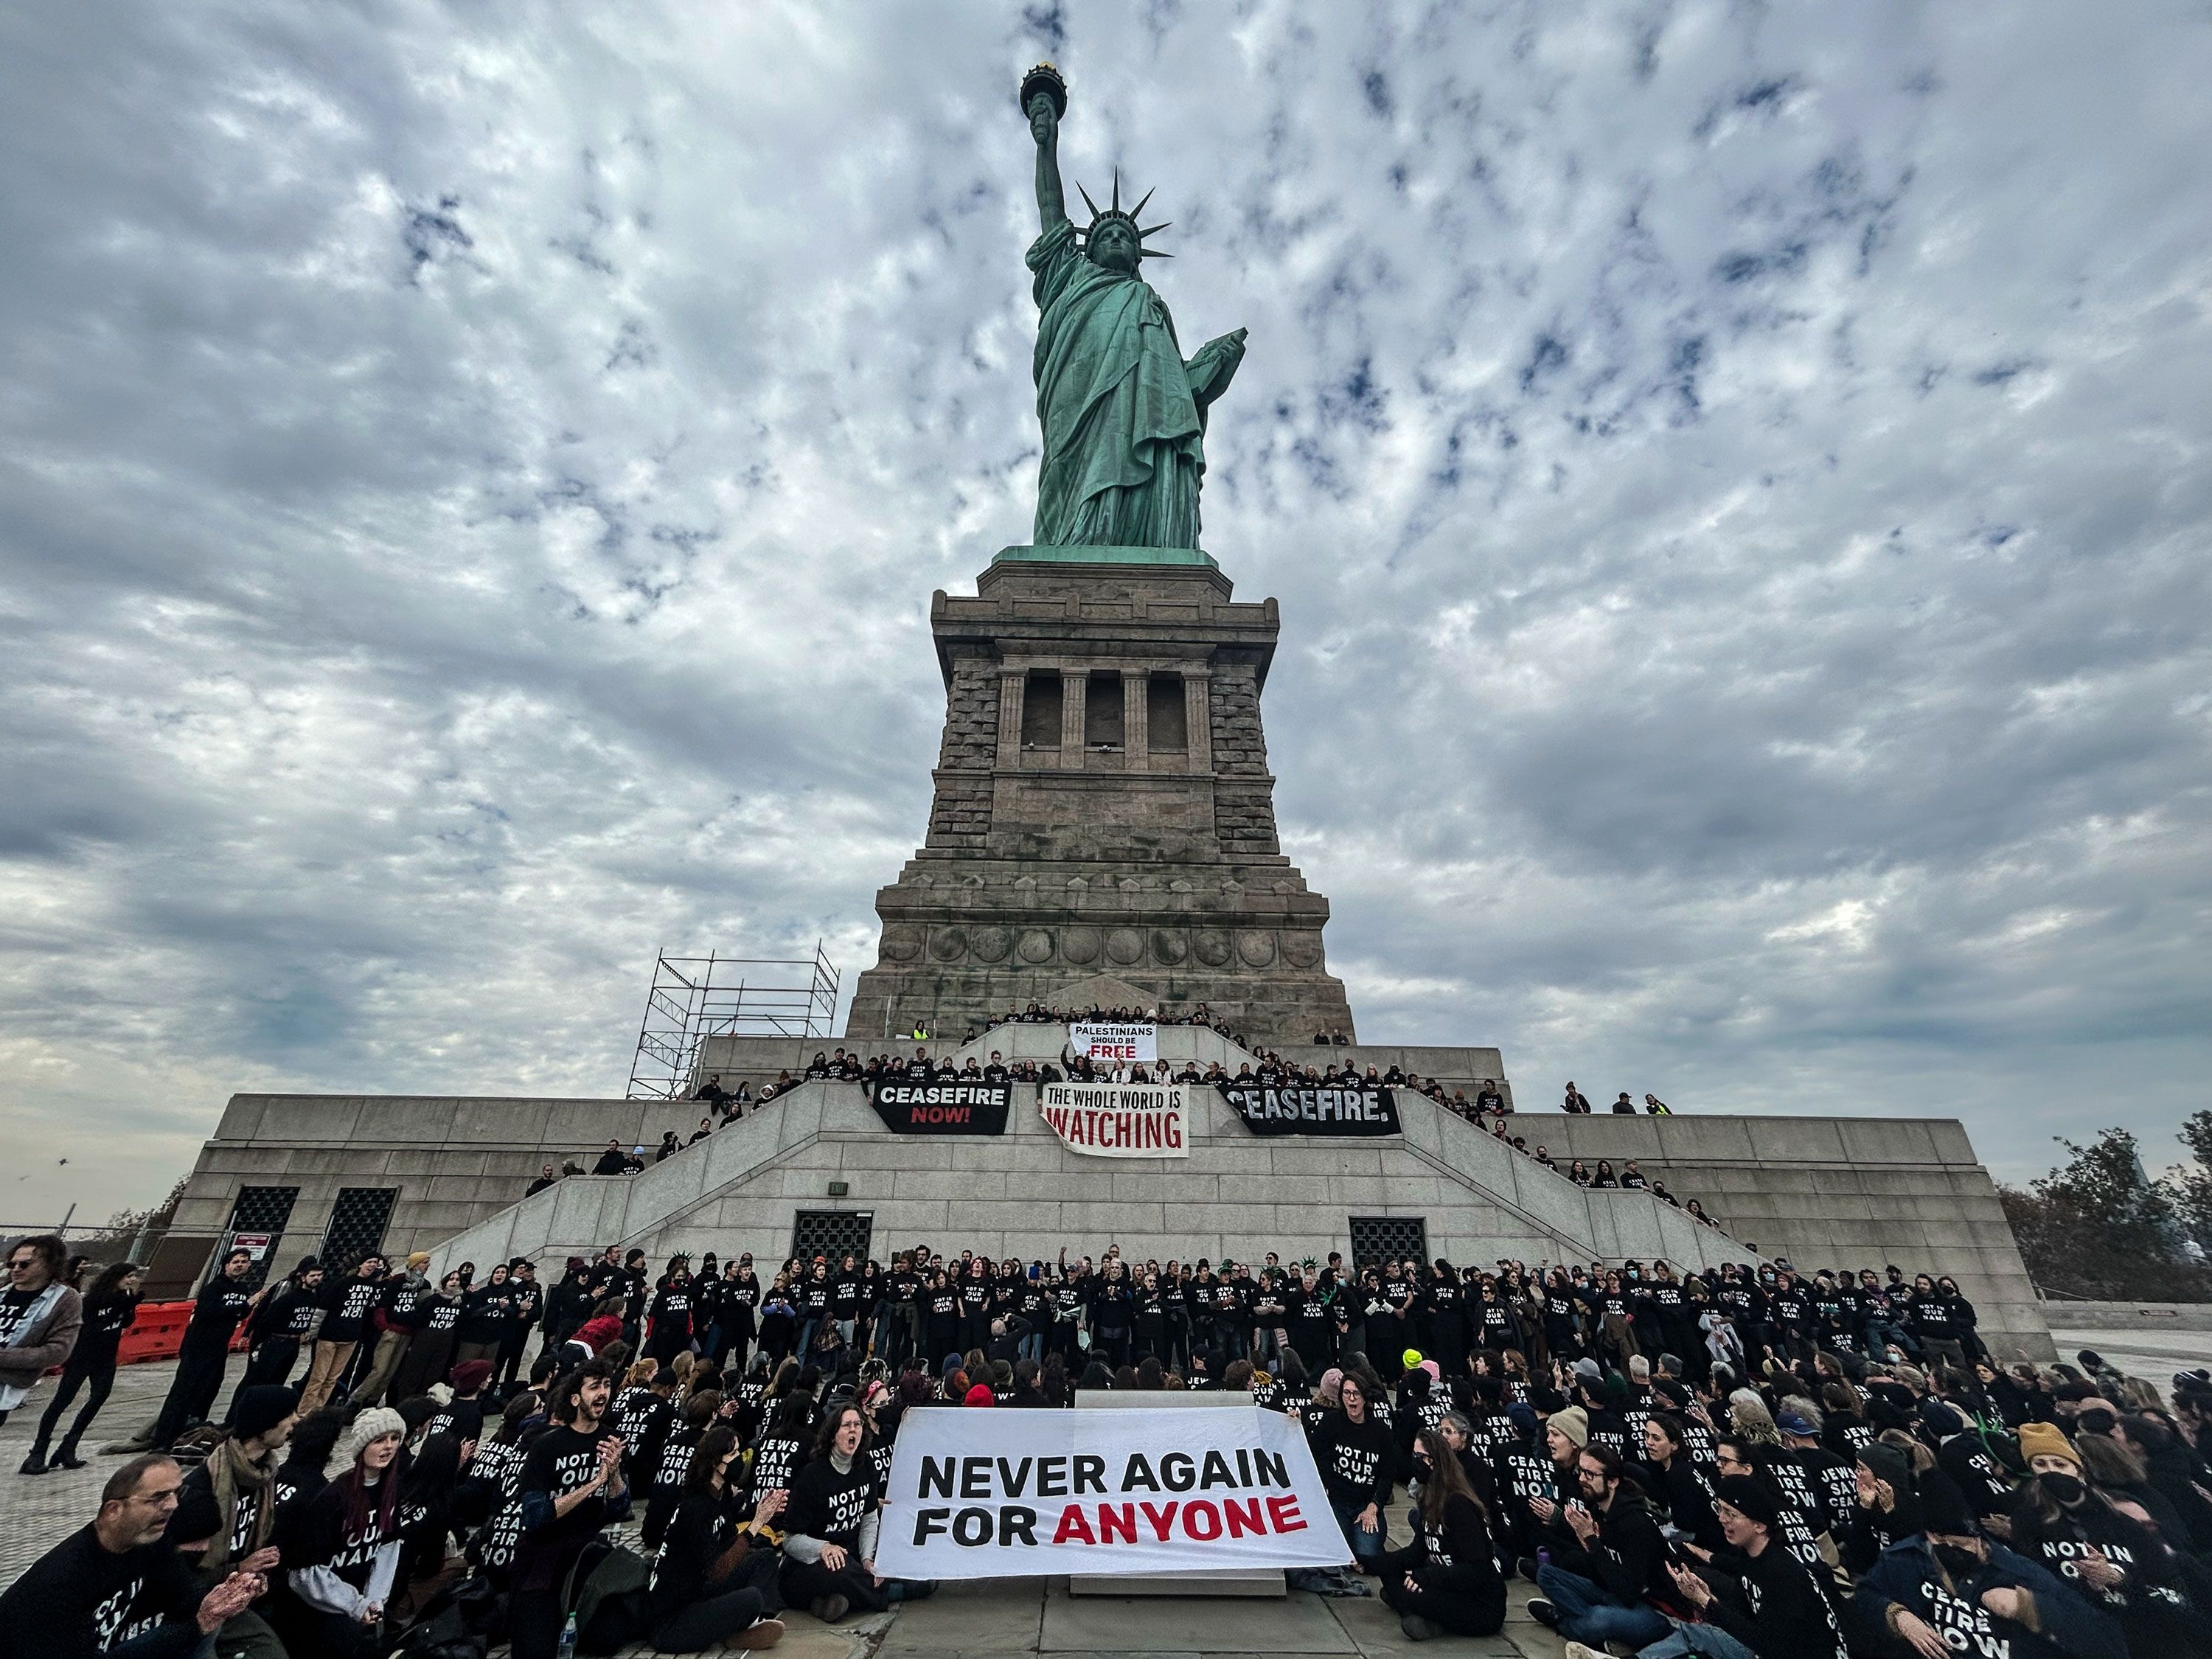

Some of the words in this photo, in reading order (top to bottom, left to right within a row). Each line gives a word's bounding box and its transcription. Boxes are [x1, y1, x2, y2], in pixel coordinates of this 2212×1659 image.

[1075, 1026, 1152, 1035] PALESTINIANS
[1091, 1045, 1135, 1058] FREE
[880, 1087, 1005, 1106] CEASEFIRE
[1048, 1088, 1070, 1105] THE
[1074, 1089, 1116, 1108] WHOLE
[1120, 1091, 1163, 1109] WORLD
[1169, 1091, 1180, 1108] IS
[911, 1107, 971, 1123] NOW!
[1046, 1107, 1181, 1148] WATCHING
[0, 1304, 19, 1318] OT
[434, 1307, 460, 1315] CEASE
[436, 1313, 455, 1321] FIRE
[428, 1320, 455, 1329] NOW
[740, 1383, 763, 1392] EWS
[1253, 1388, 1273, 1396] OUR
[1282, 1398, 1312, 1407] JEWS
[622, 1412, 647, 1423] SAY
[617, 1424, 647, 1433] CEASE
[1843, 1427, 1871, 1439] JEW
[664, 1445, 695, 1458] CEAS
[759, 1439, 799, 1453] JEWS
[478, 1451, 501, 1466] FIRE
[759, 1452, 790, 1466] SAY
[1335, 1444, 1360, 1458] NOT
[1366, 1450, 1379, 1463] IN
[1692, 1450, 1717, 1461] OW
[555, 1453, 590, 1471] NOT
[663, 1457, 690, 1470] FIRE
[874, 1459, 891, 1471] OU
[1338, 1457, 1372, 1475] OUR
[1509, 1455, 1555, 1473] CEASE
[756, 1465, 793, 1478] CEASE
[918, 1455, 1107, 1498] NEVER
[1121, 1448, 1291, 1492] AGAIN
[1517, 1467, 1551, 1481] FIRE
[1821, 1467, 1854, 1483] JEWS
[757, 1476, 784, 1488] FIRE
[1777, 1477, 1806, 1489] IRE
[1831, 1481, 1857, 1495] SAY
[829, 1489, 855, 1508] NOT
[859, 1483, 870, 1496] IN
[1512, 1481, 1559, 1500] NOW
[1784, 1491, 1815, 1508] OW
[1829, 1495, 1857, 1508] CEAS
[836, 1500, 865, 1520] OUR
[913, 1506, 1037, 1545] FOR
[1053, 1494, 1307, 1545] ANYONE
[492, 1532, 517, 1545] FIR
[1785, 1525, 1814, 1542] FIRE
[2042, 1540, 2088, 1557] NOT
[2101, 1544, 2133, 1563] IN
[1933, 1603, 1991, 1632] FIRE
